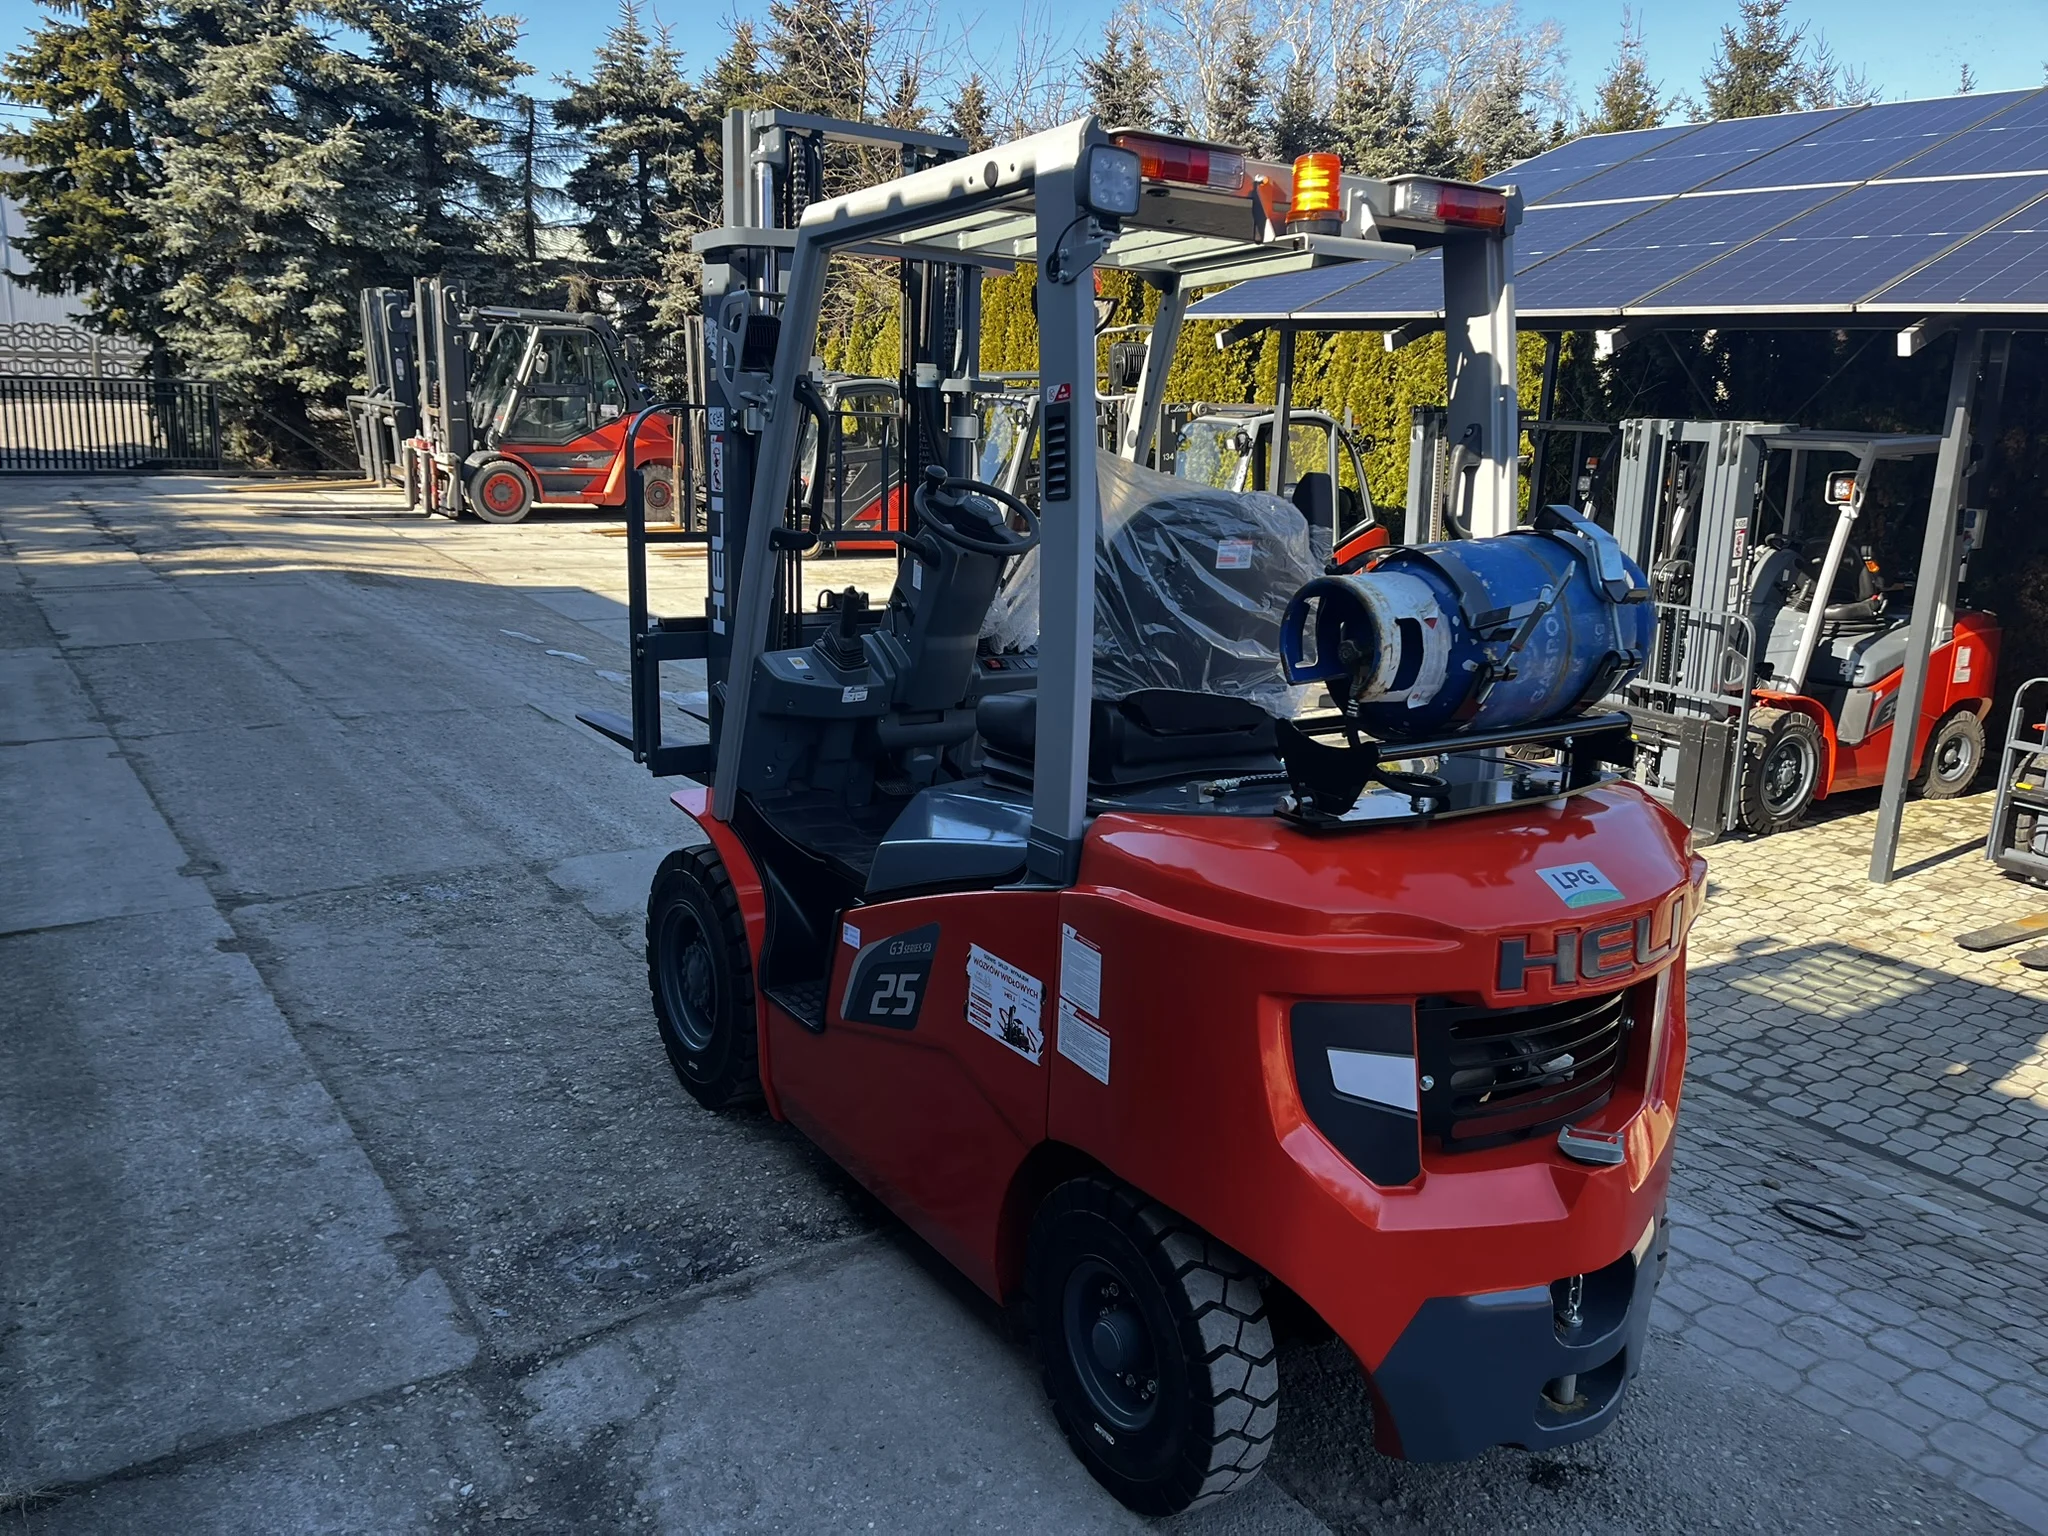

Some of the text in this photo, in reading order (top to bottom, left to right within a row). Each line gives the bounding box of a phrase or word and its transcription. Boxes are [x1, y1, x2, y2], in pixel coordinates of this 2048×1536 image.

[1163, 453, 1174, 461] 134
[711, 497, 726, 635] HELI
[1552, 869, 1600, 890] LPG
[889, 941, 905, 955] G3
[1498, 900, 1684, 991] HELI
[869, 973, 921, 1015] 25
[1000, 971, 1040, 1000] WIDŁOWYCH
